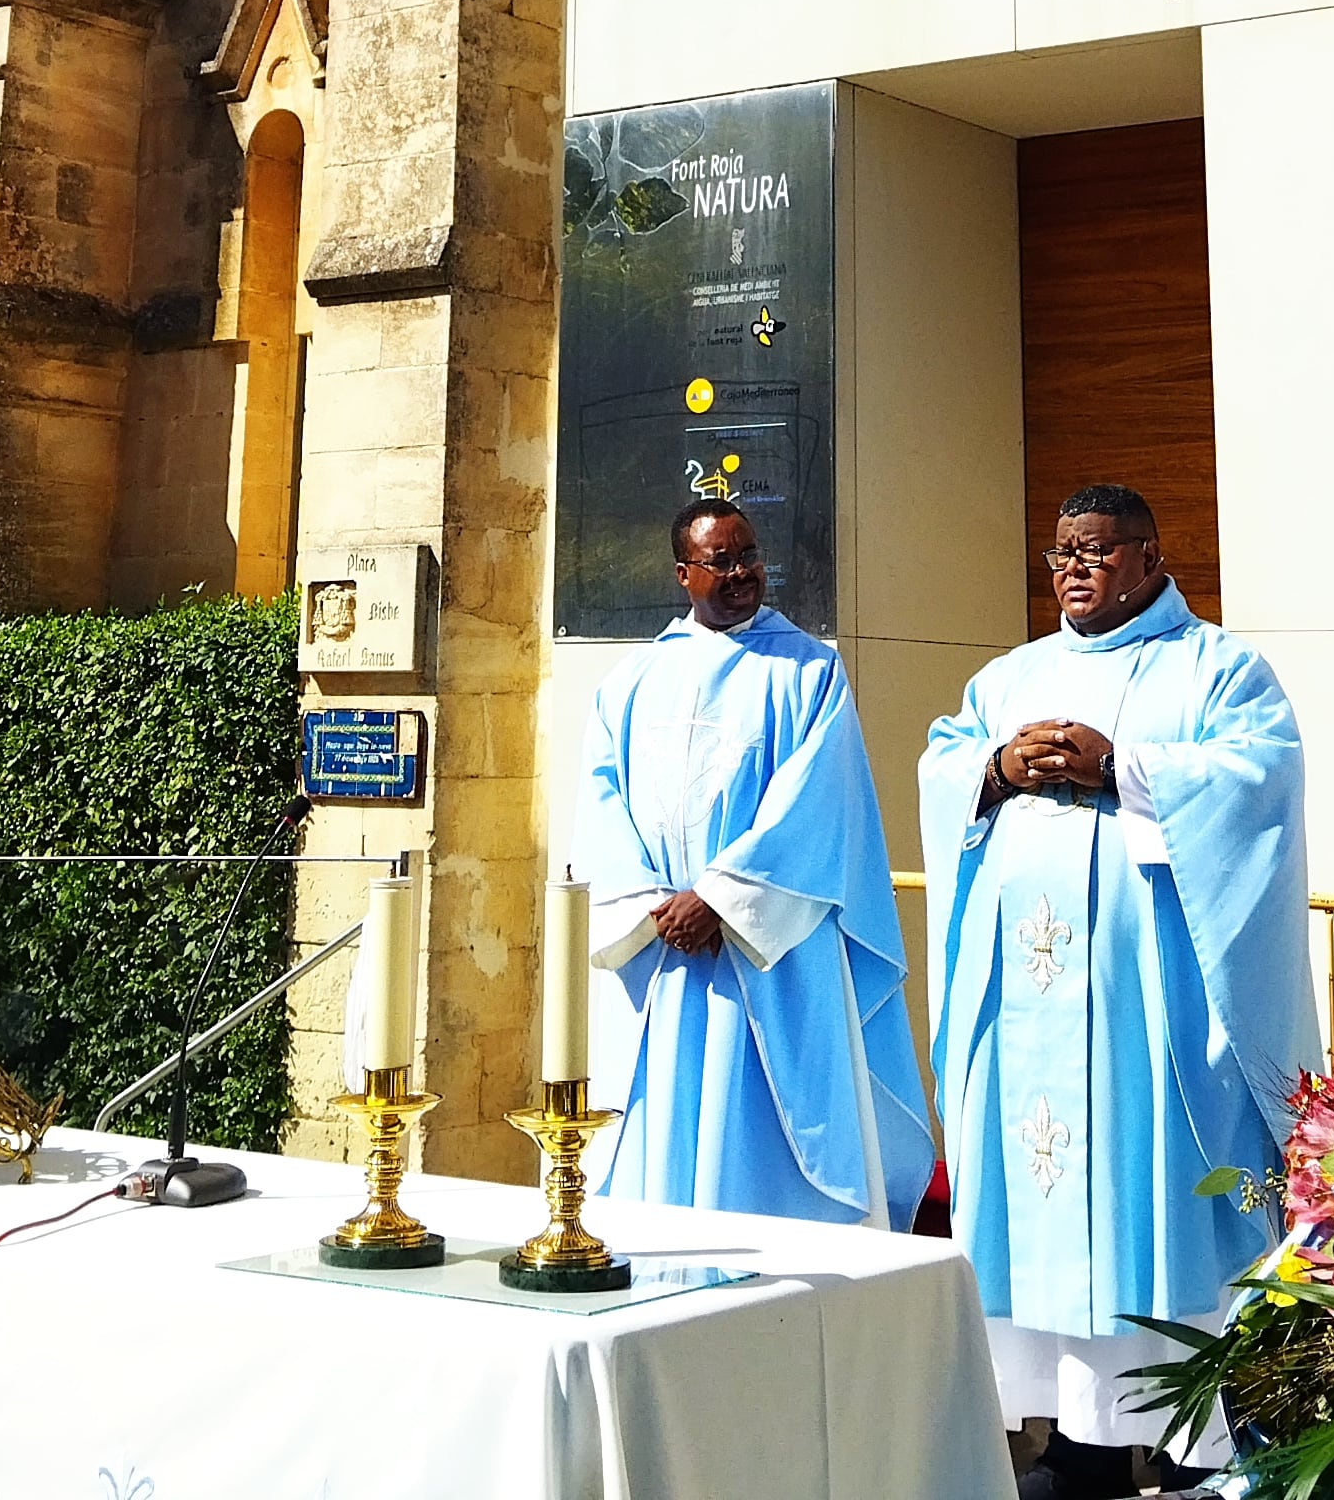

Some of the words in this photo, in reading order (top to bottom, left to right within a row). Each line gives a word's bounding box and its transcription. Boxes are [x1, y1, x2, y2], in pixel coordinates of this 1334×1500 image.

[671, 154, 707, 182] Font
[709, 147, 745, 181] Roja
[693, 171, 791, 219] NATURA
